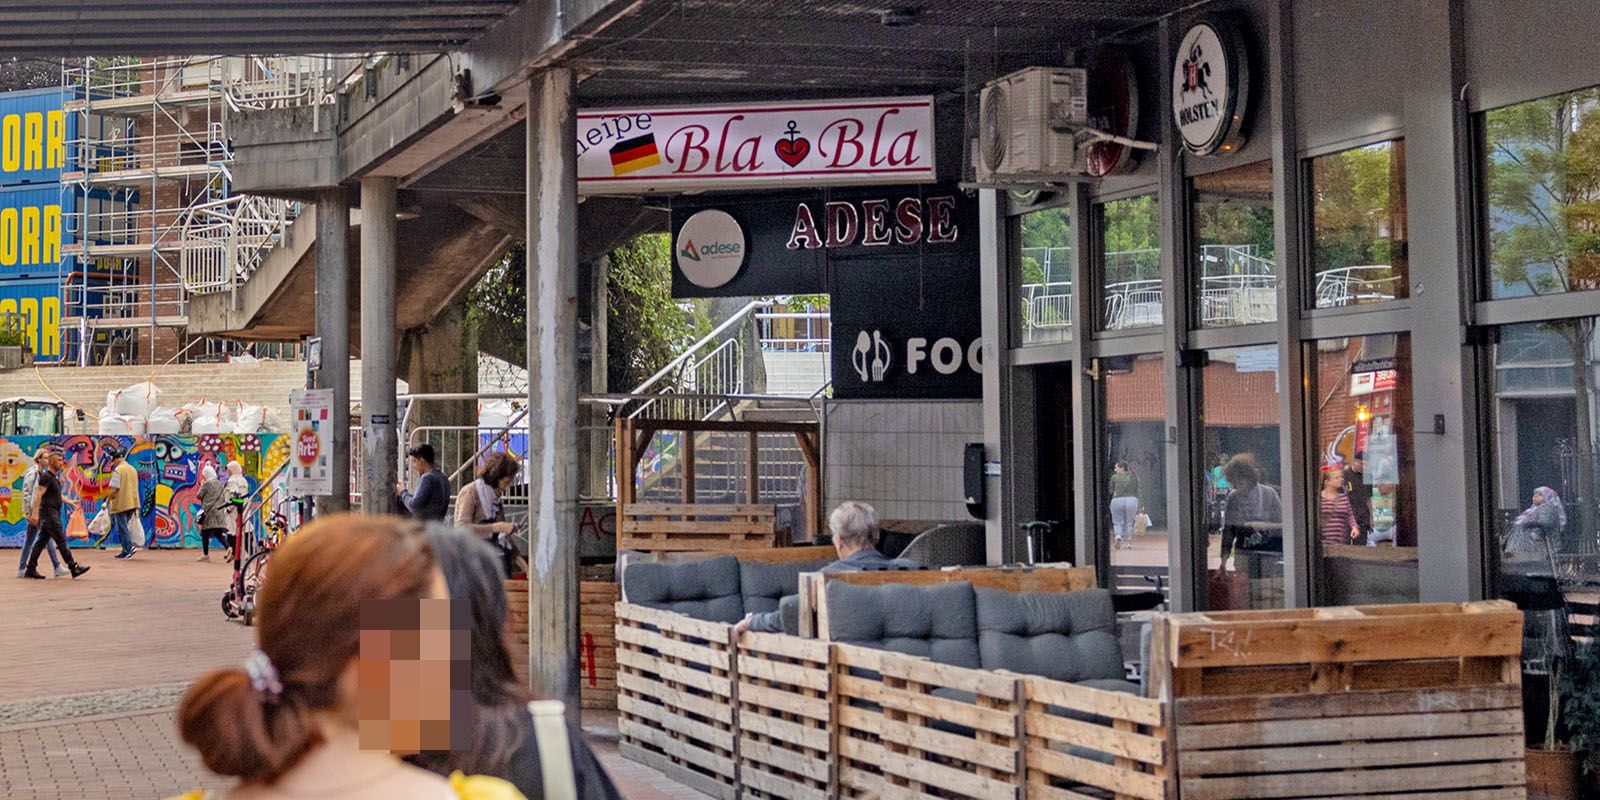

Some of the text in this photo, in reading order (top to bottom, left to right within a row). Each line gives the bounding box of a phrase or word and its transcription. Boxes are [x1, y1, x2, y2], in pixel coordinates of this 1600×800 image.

[1179, 100, 1220, 127] HOLSTEN
[665, 108, 921, 174] Bla Bla
[786, 196, 959, 250] ADESE
[701, 241, 741, 256] adese
